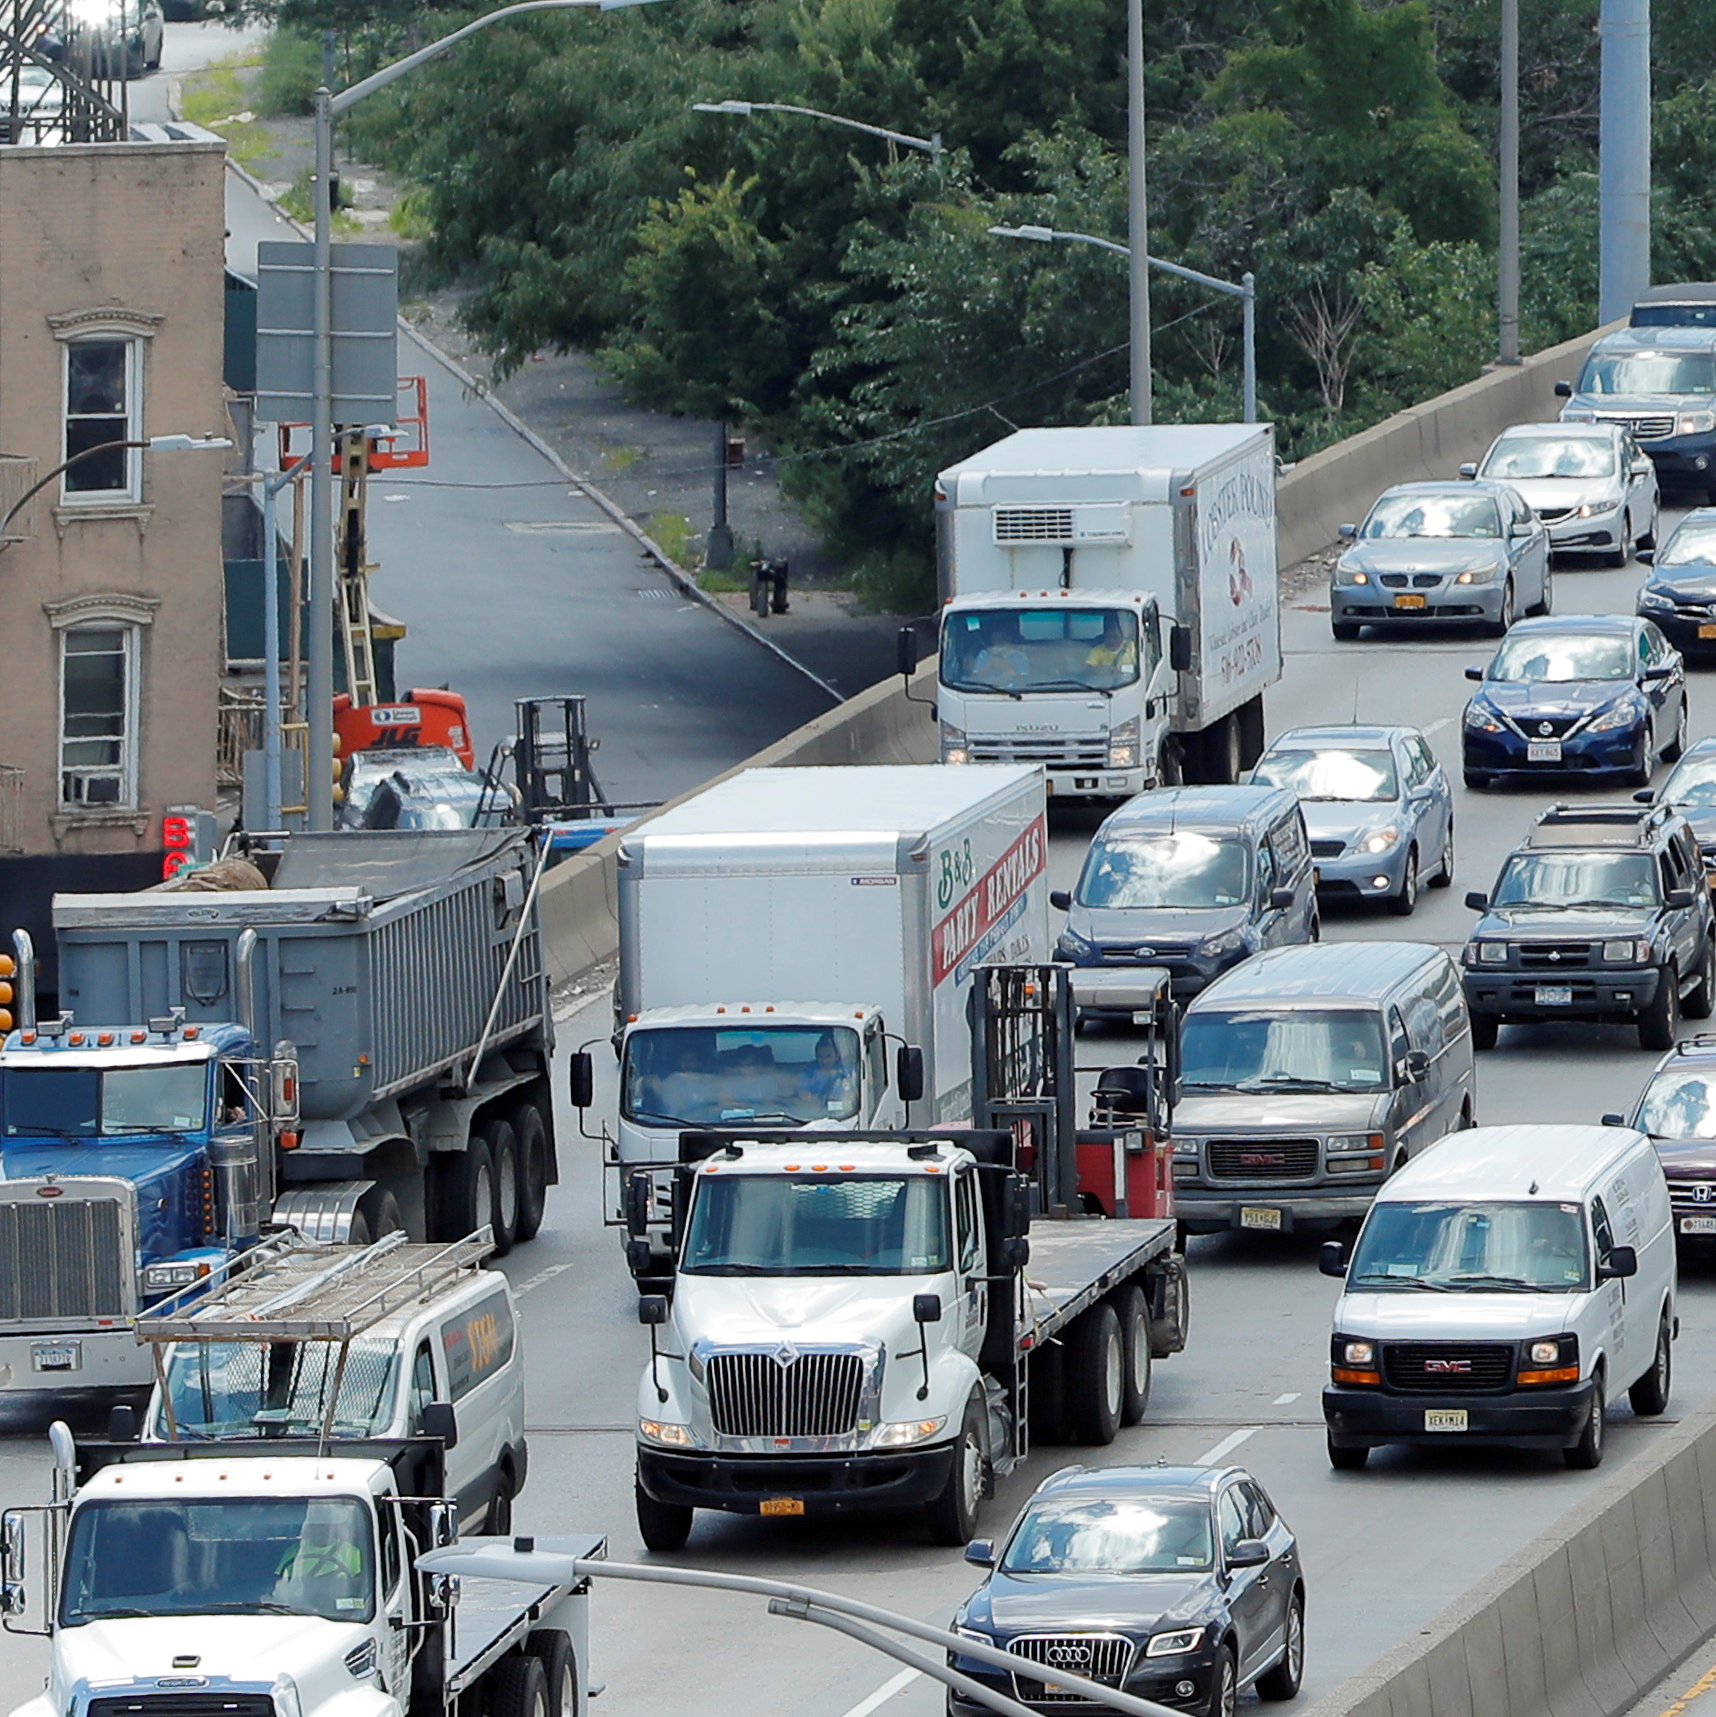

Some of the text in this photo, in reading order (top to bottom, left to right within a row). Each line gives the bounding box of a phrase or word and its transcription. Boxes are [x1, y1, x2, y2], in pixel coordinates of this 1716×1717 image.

[1016, 723, 1060, 732] ISUZU
[371, 727, 422, 747] JLG
[942, 891, 980, 971] PARTY
[986, 827, 1041, 923] RENTALS
[1242, 1153, 1285, 1164] GMC
[1424, 1359, 1472, 1374] GMC
